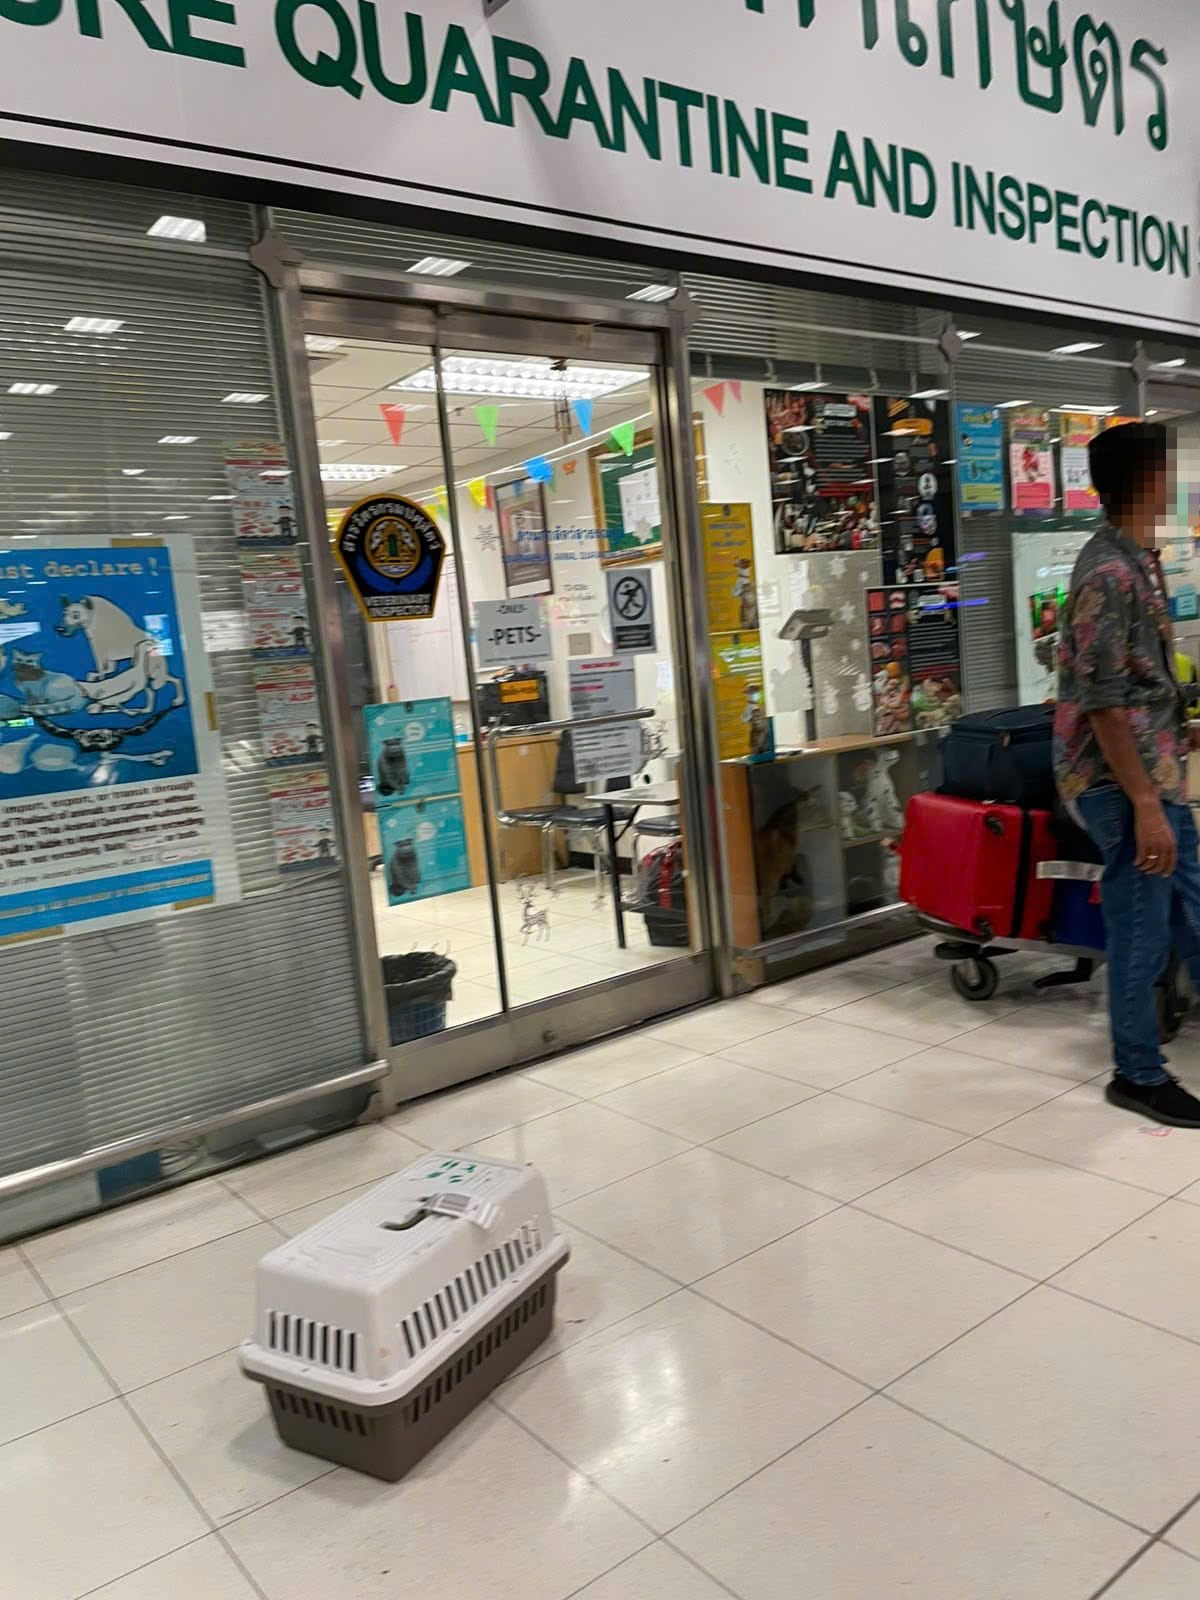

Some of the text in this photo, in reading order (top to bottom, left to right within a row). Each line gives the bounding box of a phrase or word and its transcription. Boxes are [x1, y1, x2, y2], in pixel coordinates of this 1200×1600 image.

[0, 0, 1190, 279] RE QUARANTINE AND INSPECTION
[0, 564, 34, 579] st
[44, 560, 144, 578] declare
